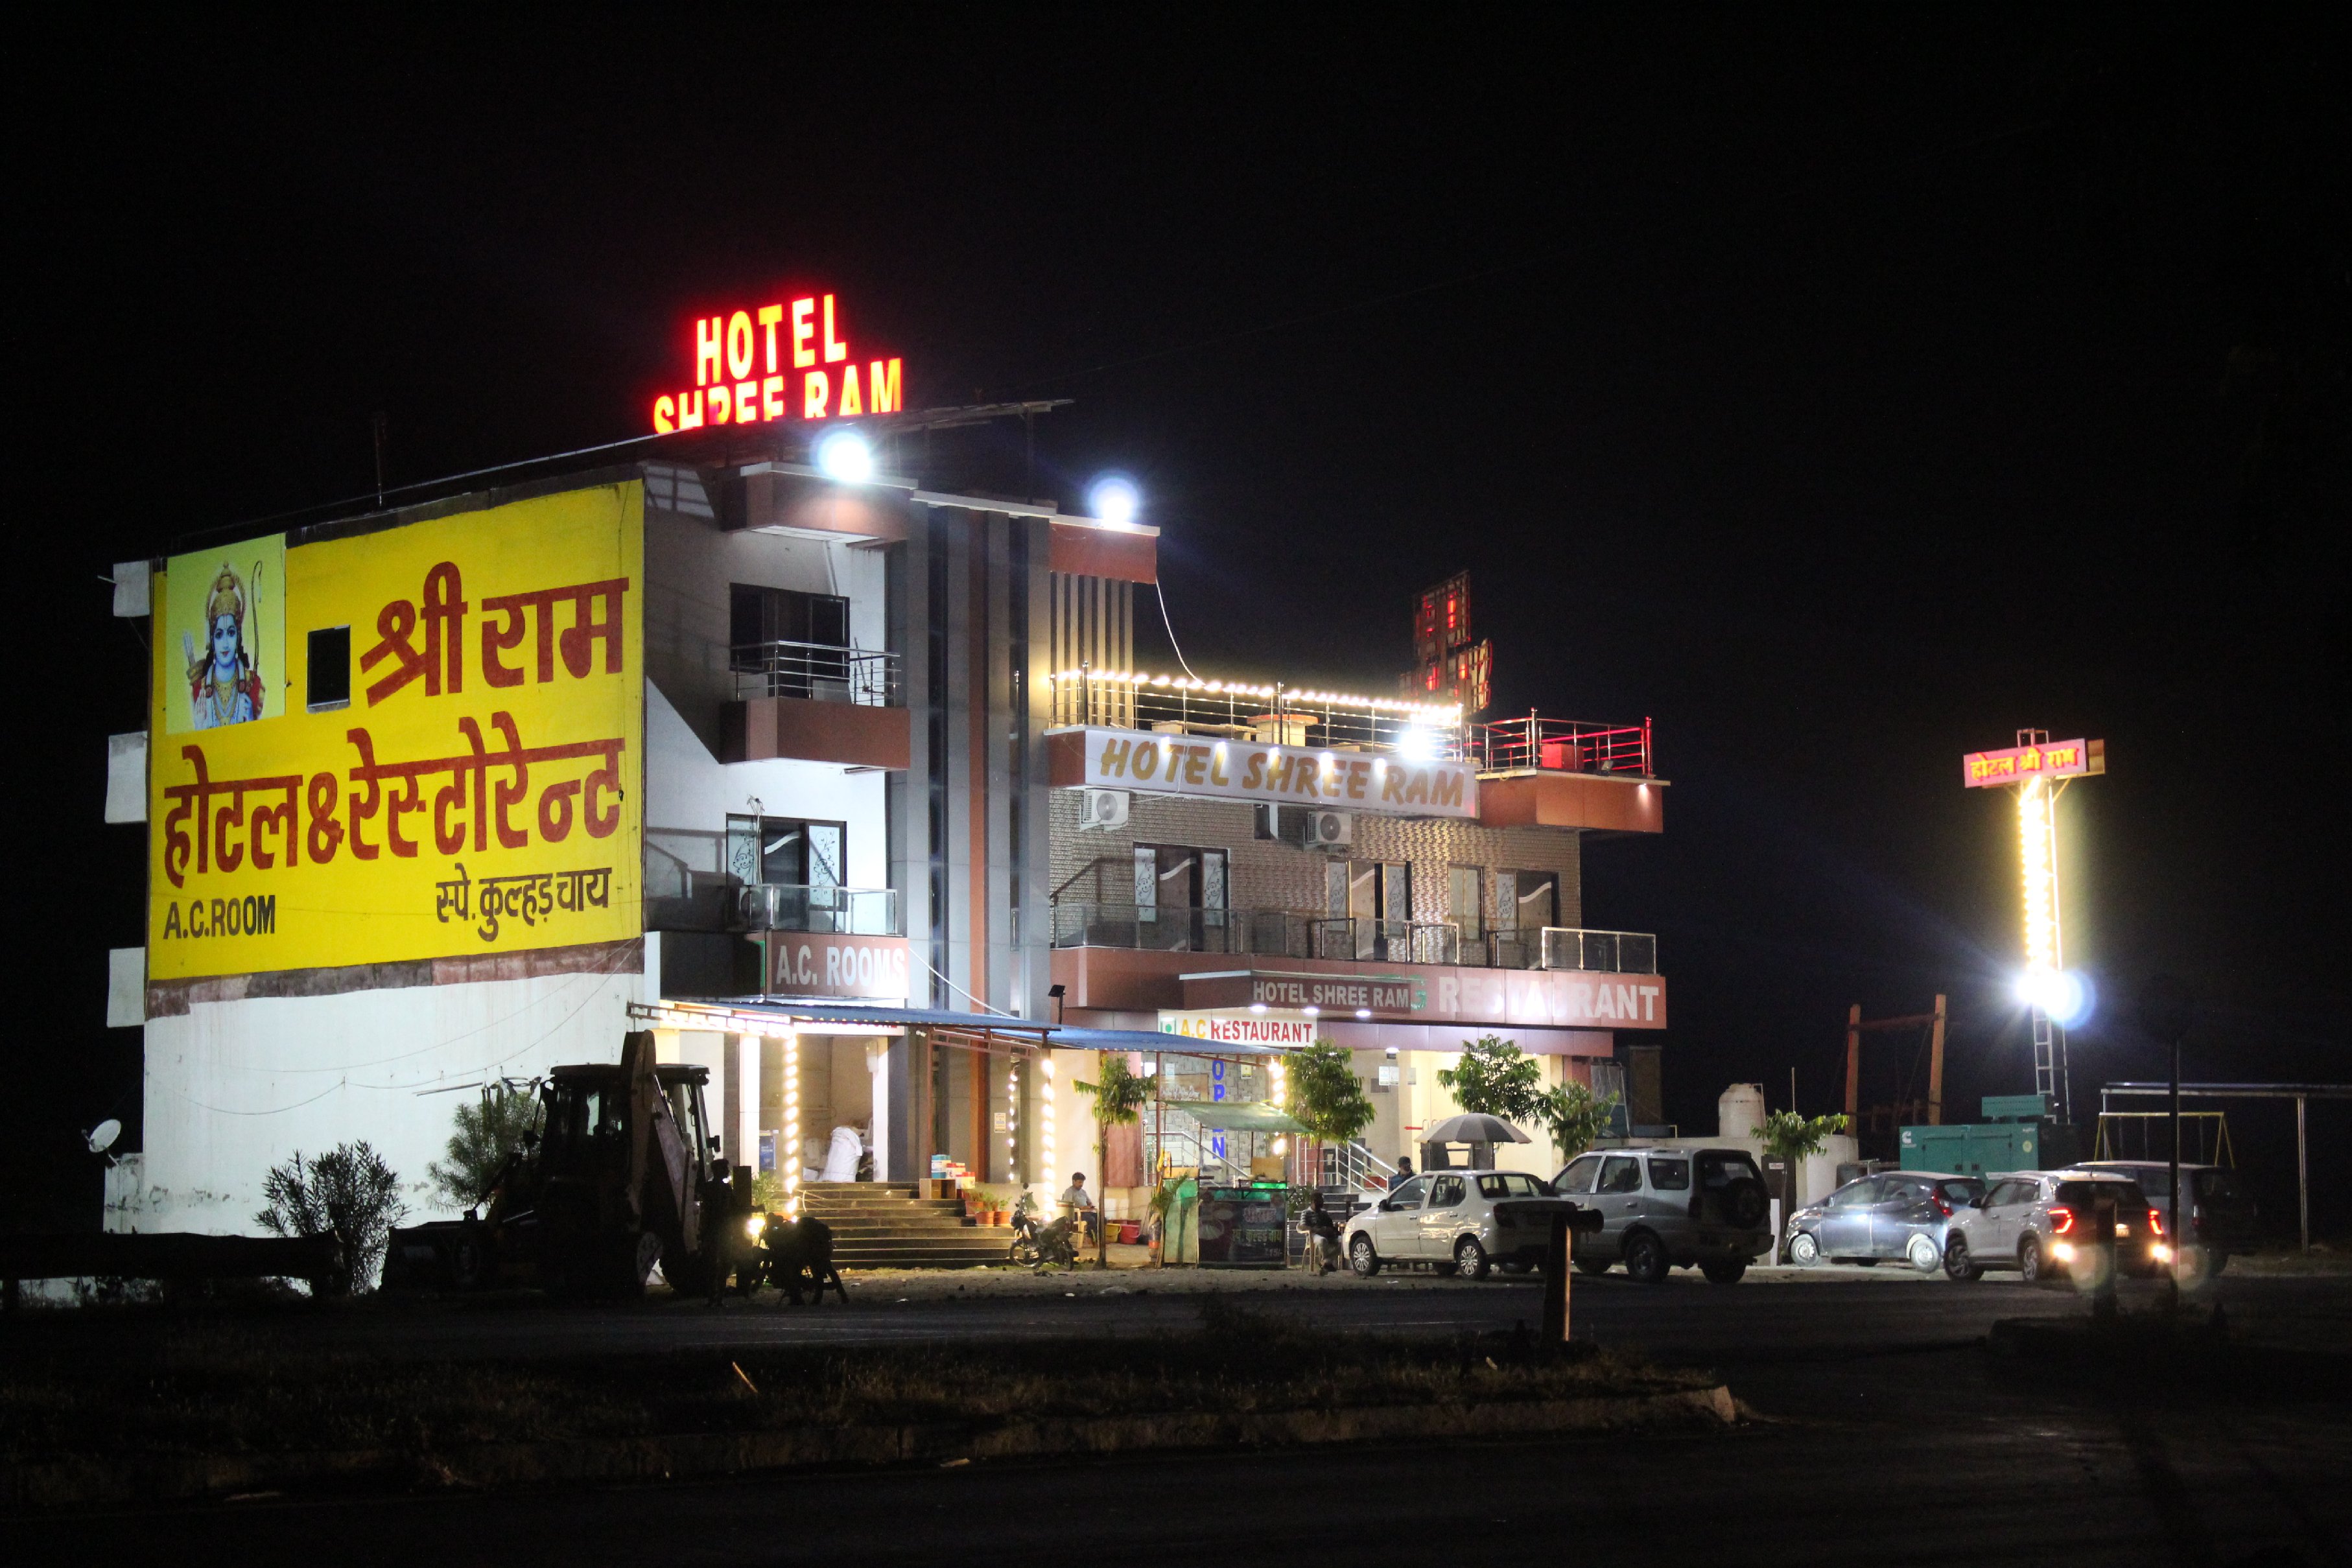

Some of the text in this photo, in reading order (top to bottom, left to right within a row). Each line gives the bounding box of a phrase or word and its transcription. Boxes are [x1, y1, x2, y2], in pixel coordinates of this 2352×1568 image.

[696, 294, 847, 386] HOTEL
[804, 357, 902, 419] RAM
[359, 561, 629, 708] श्री राम
[1100, 738, 1464, 808] HOTEL SHREE RAM
[1970, 747, 2080, 782] होटल श्री राम
[556, 867, 613, 913] चाय
[776, 944, 906, 987] A.C. ROOMS
[1252, 980, 1308, 1003] HOTEL
[1312, 984, 1367, 1006] SHREE
[1372, 988, 1409, 1008] RAM
[1438, 976, 1660, 1022] RESTAURANT
[1210, 1019, 1313, 1043] RESTAURANT
[1212, 1060, 1225, 1160] OPN
